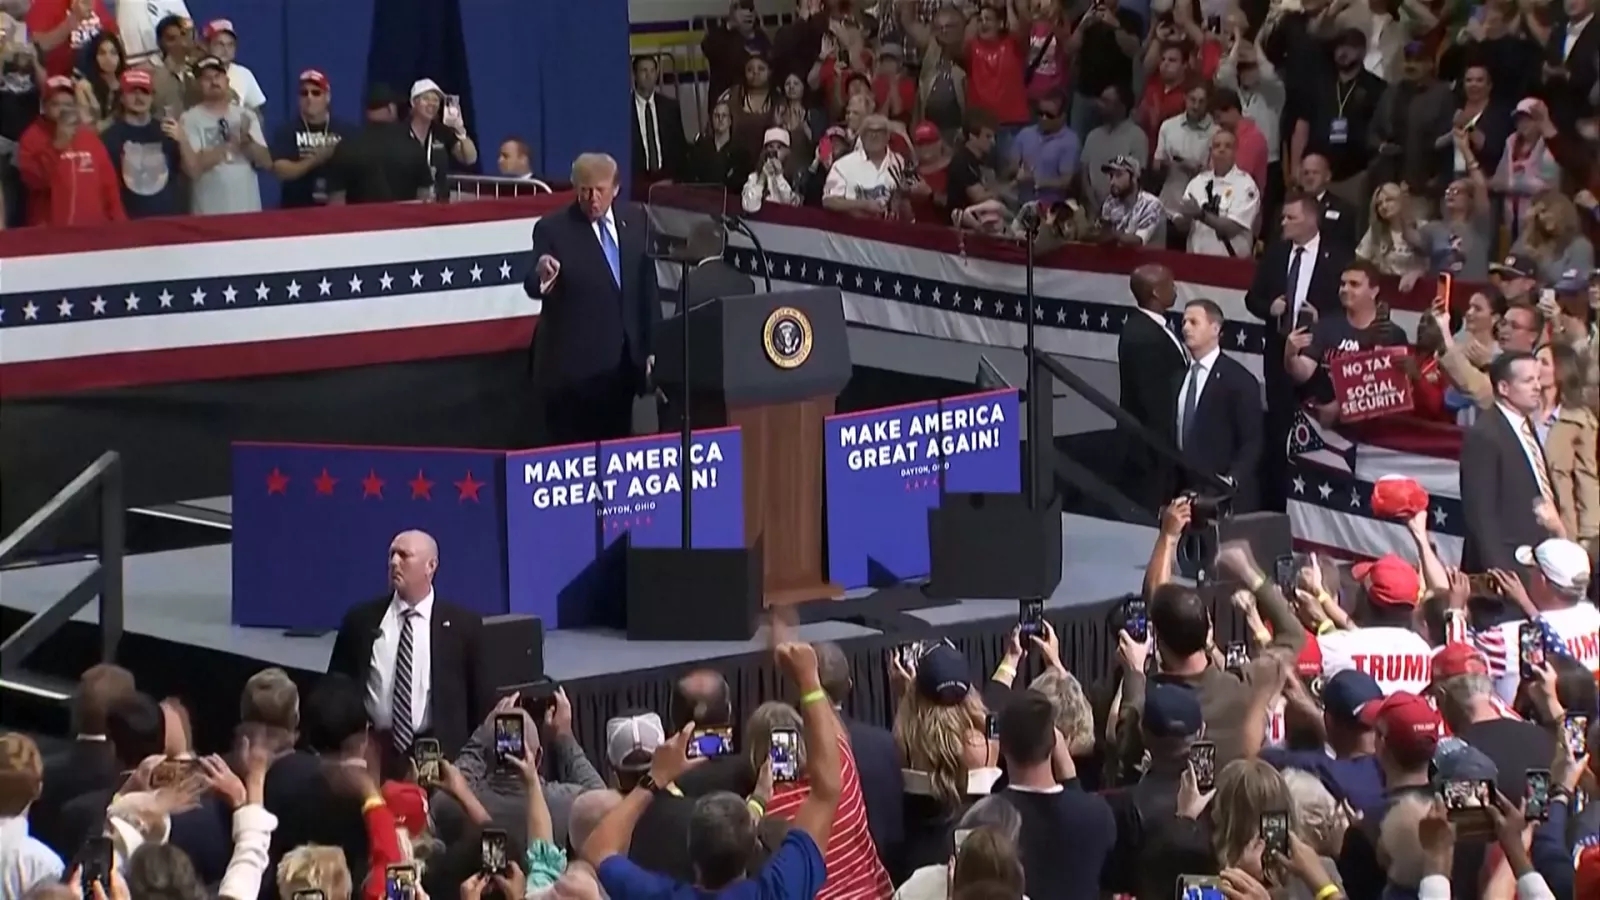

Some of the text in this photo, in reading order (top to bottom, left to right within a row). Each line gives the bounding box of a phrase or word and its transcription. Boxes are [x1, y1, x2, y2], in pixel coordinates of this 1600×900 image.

[1342, 355, 1392, 378] NO TAX
[1341, 389, 1406, 416] SECURITY
[1346, 378, 1397, 401] SOCIAL
[840, 403, 1005, 447] MAKE AMERICA
[848, 428, 1000, 470] GREAT AGAIN!
[524, 456, 597, 484] MAKE
[932, 461, 950, 472] OO
[533, 467, 717, 509] GREAT AGAN!
[635, 501, 656, 512] OHIO
